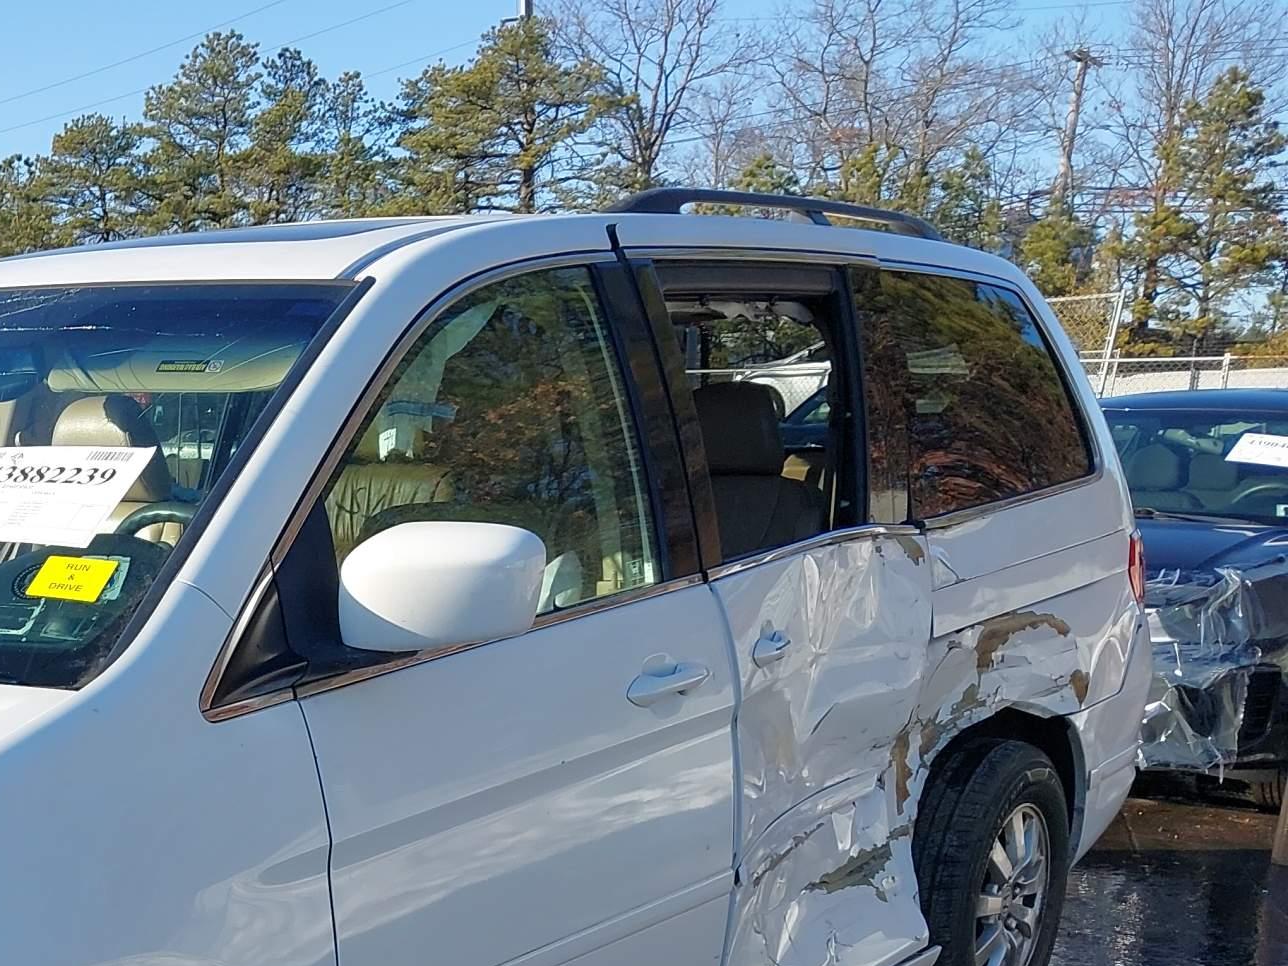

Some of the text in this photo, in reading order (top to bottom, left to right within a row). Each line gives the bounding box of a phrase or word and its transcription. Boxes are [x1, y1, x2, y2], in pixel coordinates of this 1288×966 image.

[65, 563, 91, 572] RUN
[67, 573, 75, 581] &
[48, 582, 84, 592] DRIVE
